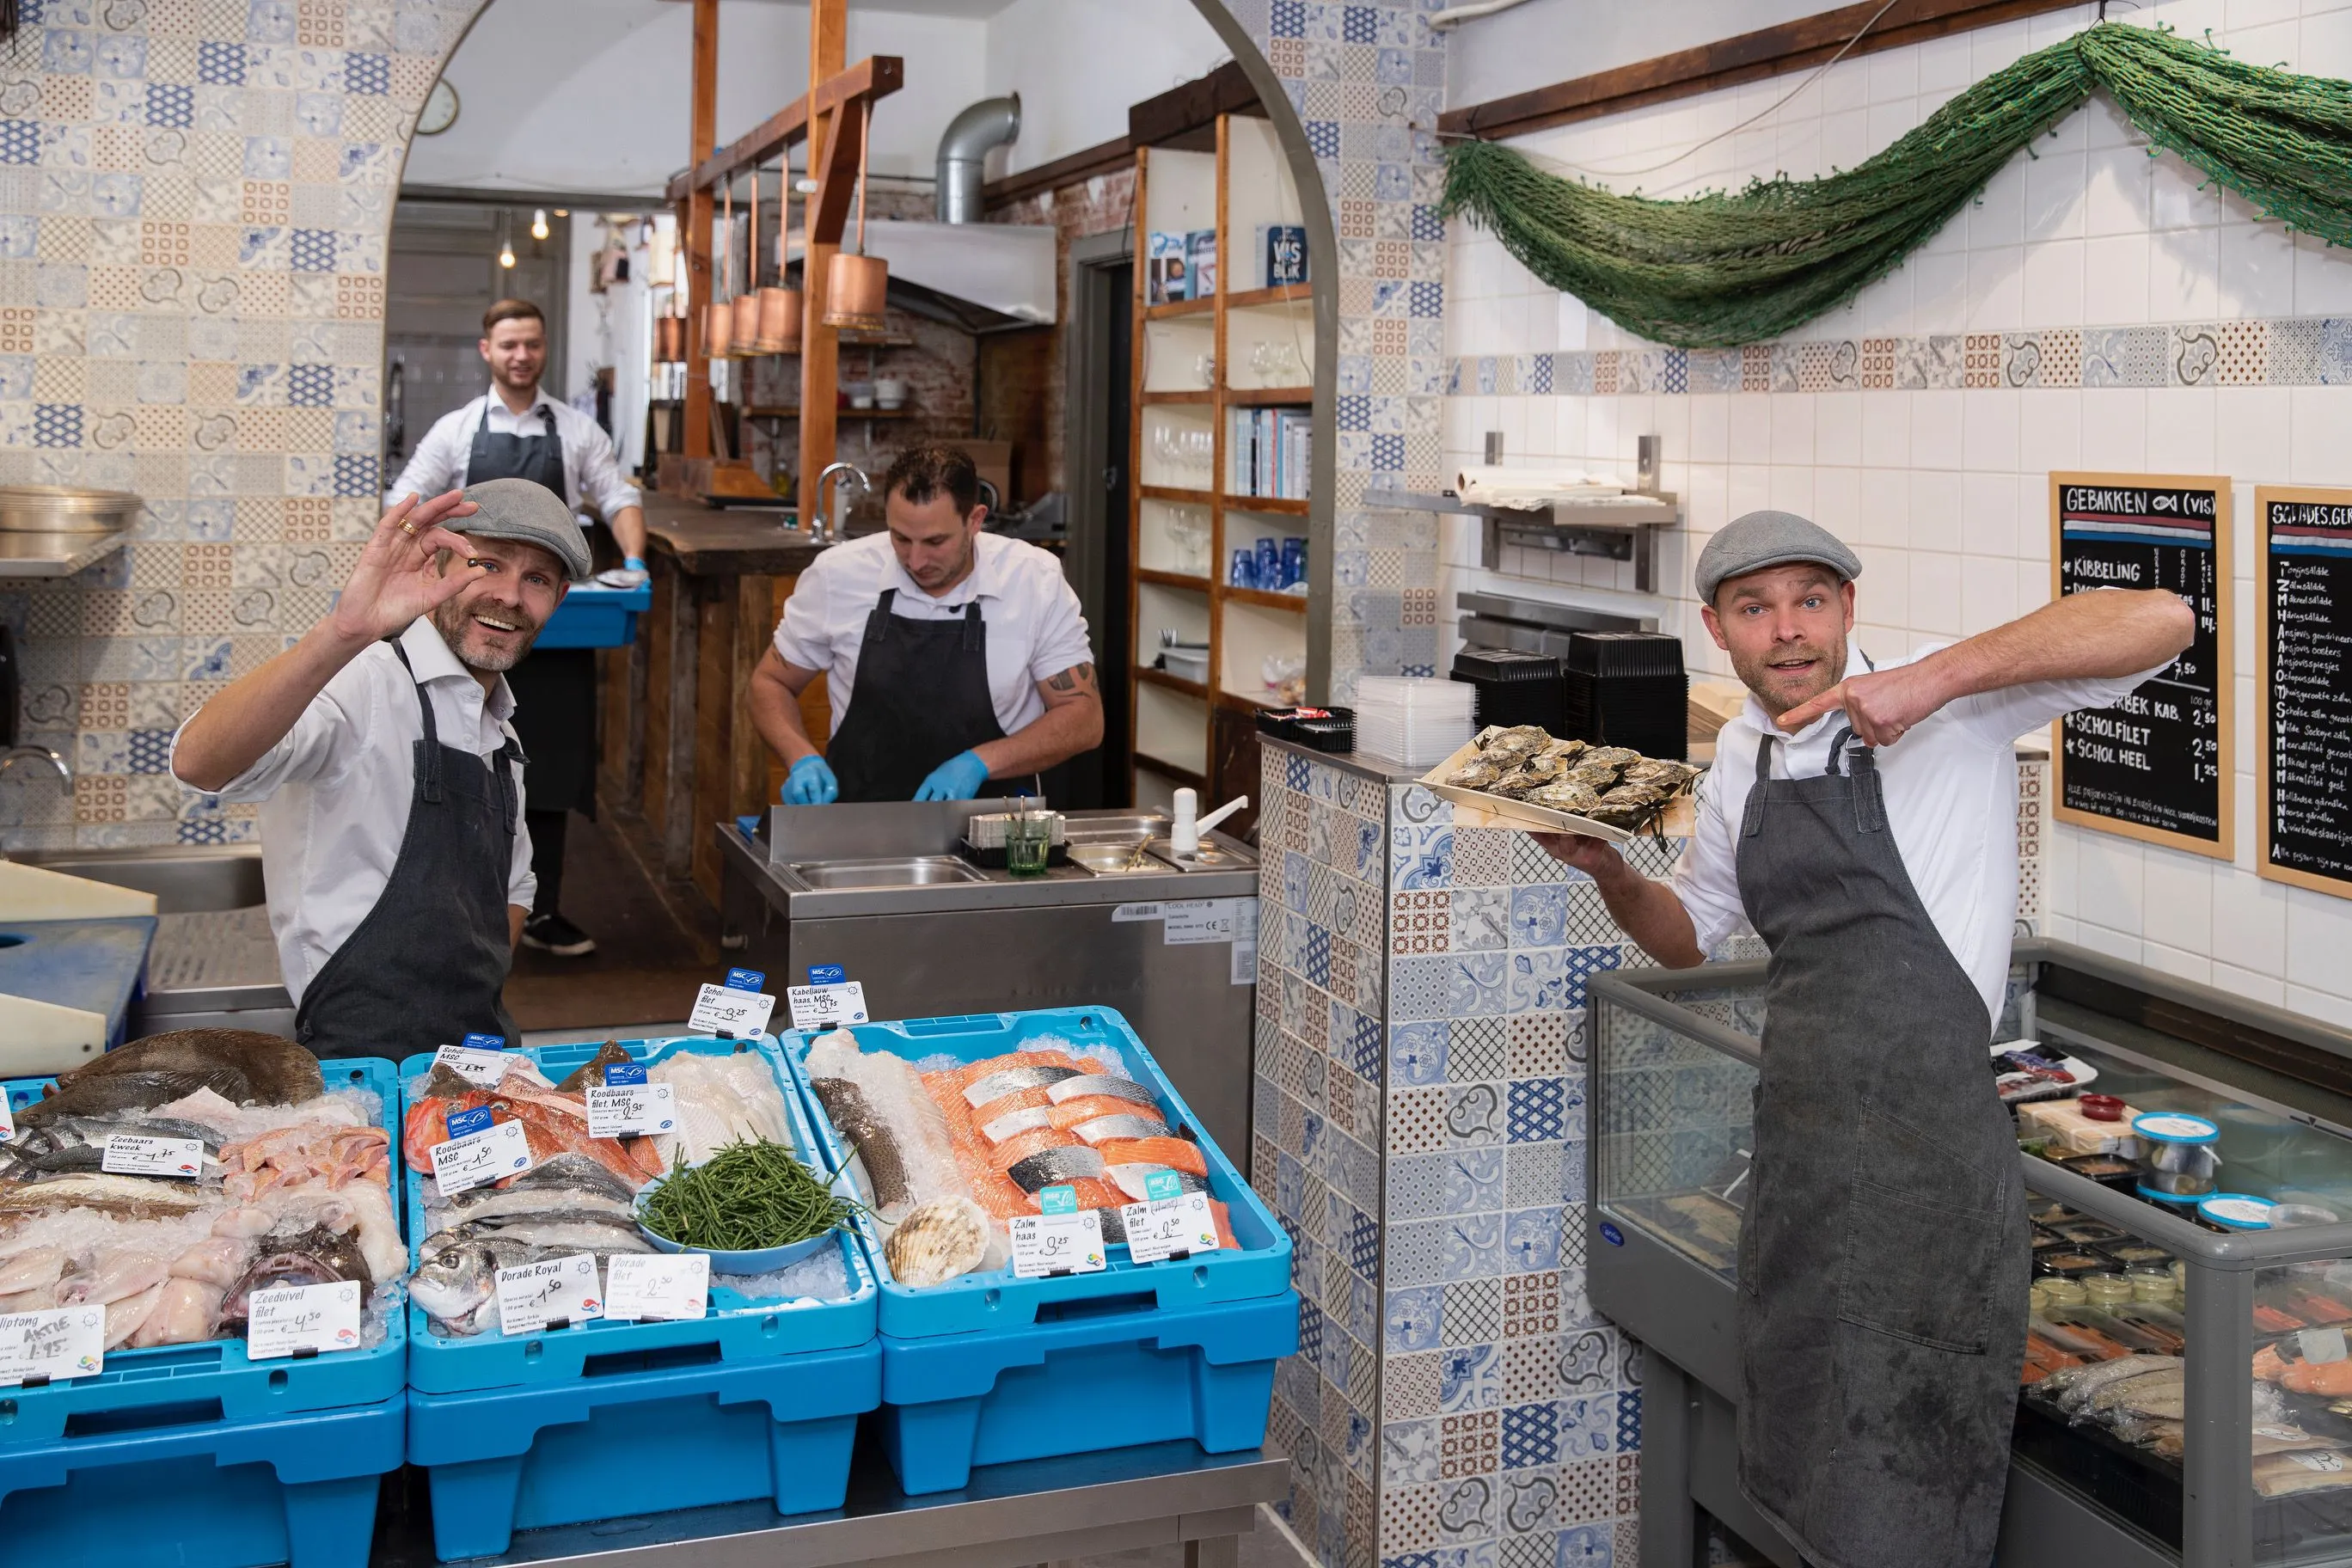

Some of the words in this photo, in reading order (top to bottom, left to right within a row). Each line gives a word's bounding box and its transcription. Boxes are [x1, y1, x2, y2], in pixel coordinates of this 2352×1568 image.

[1273, 242, 1302, 263] VIS
[2067, 487, 2147, 514] GEBAKKEN
[2277, 624, 2311, 641] Ansjovis
[2277, 640, 2310, 656] Ansjovis
[2190, 695, 2202, 705] 100
[2154, 701, 2182, 722] KAB.
[2276, 720, 2300, 734] Wilde
[2077, 738, 2116, 763] SCHOL
[2119, 750, 2151, 770] HEEL
[2067, 784, 2081, 796] ALLE
[2272, 843, 2290, 859] Alle
[704, 986, 724, 996] Schol
[591, 1089, 634, 1099] Roodbaars
[611, 1098, 631, 1107] MSC
[451, 1116, 467, 1126] MSC
[110, 1142, 142, 1151] kweek
[111, 1136, 154, 1145] Zeebaars
[436, 1136, 481, 1156] Roodbaars
[438, 1153, 458, 1166] MSC
[1126, 1205, 1147, 1216] Zalm
[1014, 1219, 1035, 1228] Zalm
[1130, 1218, 1144, 1228] filet
[1016, 1231, 1036, 1241] haas
[614, 1258, 646, 1268] Dorade
[502, 1267, 532, 1282] Dorade
[535, 1261, 561, 1277] Royal
[613, 1269, 633, 1281] filet
[254, 1289, 305, 1304] Zeeduivel
[255, 1306, 275, 1318] filet
[23, 1315, 70, 1343] AKTIE
[280, 1324, 287, 1332] €
